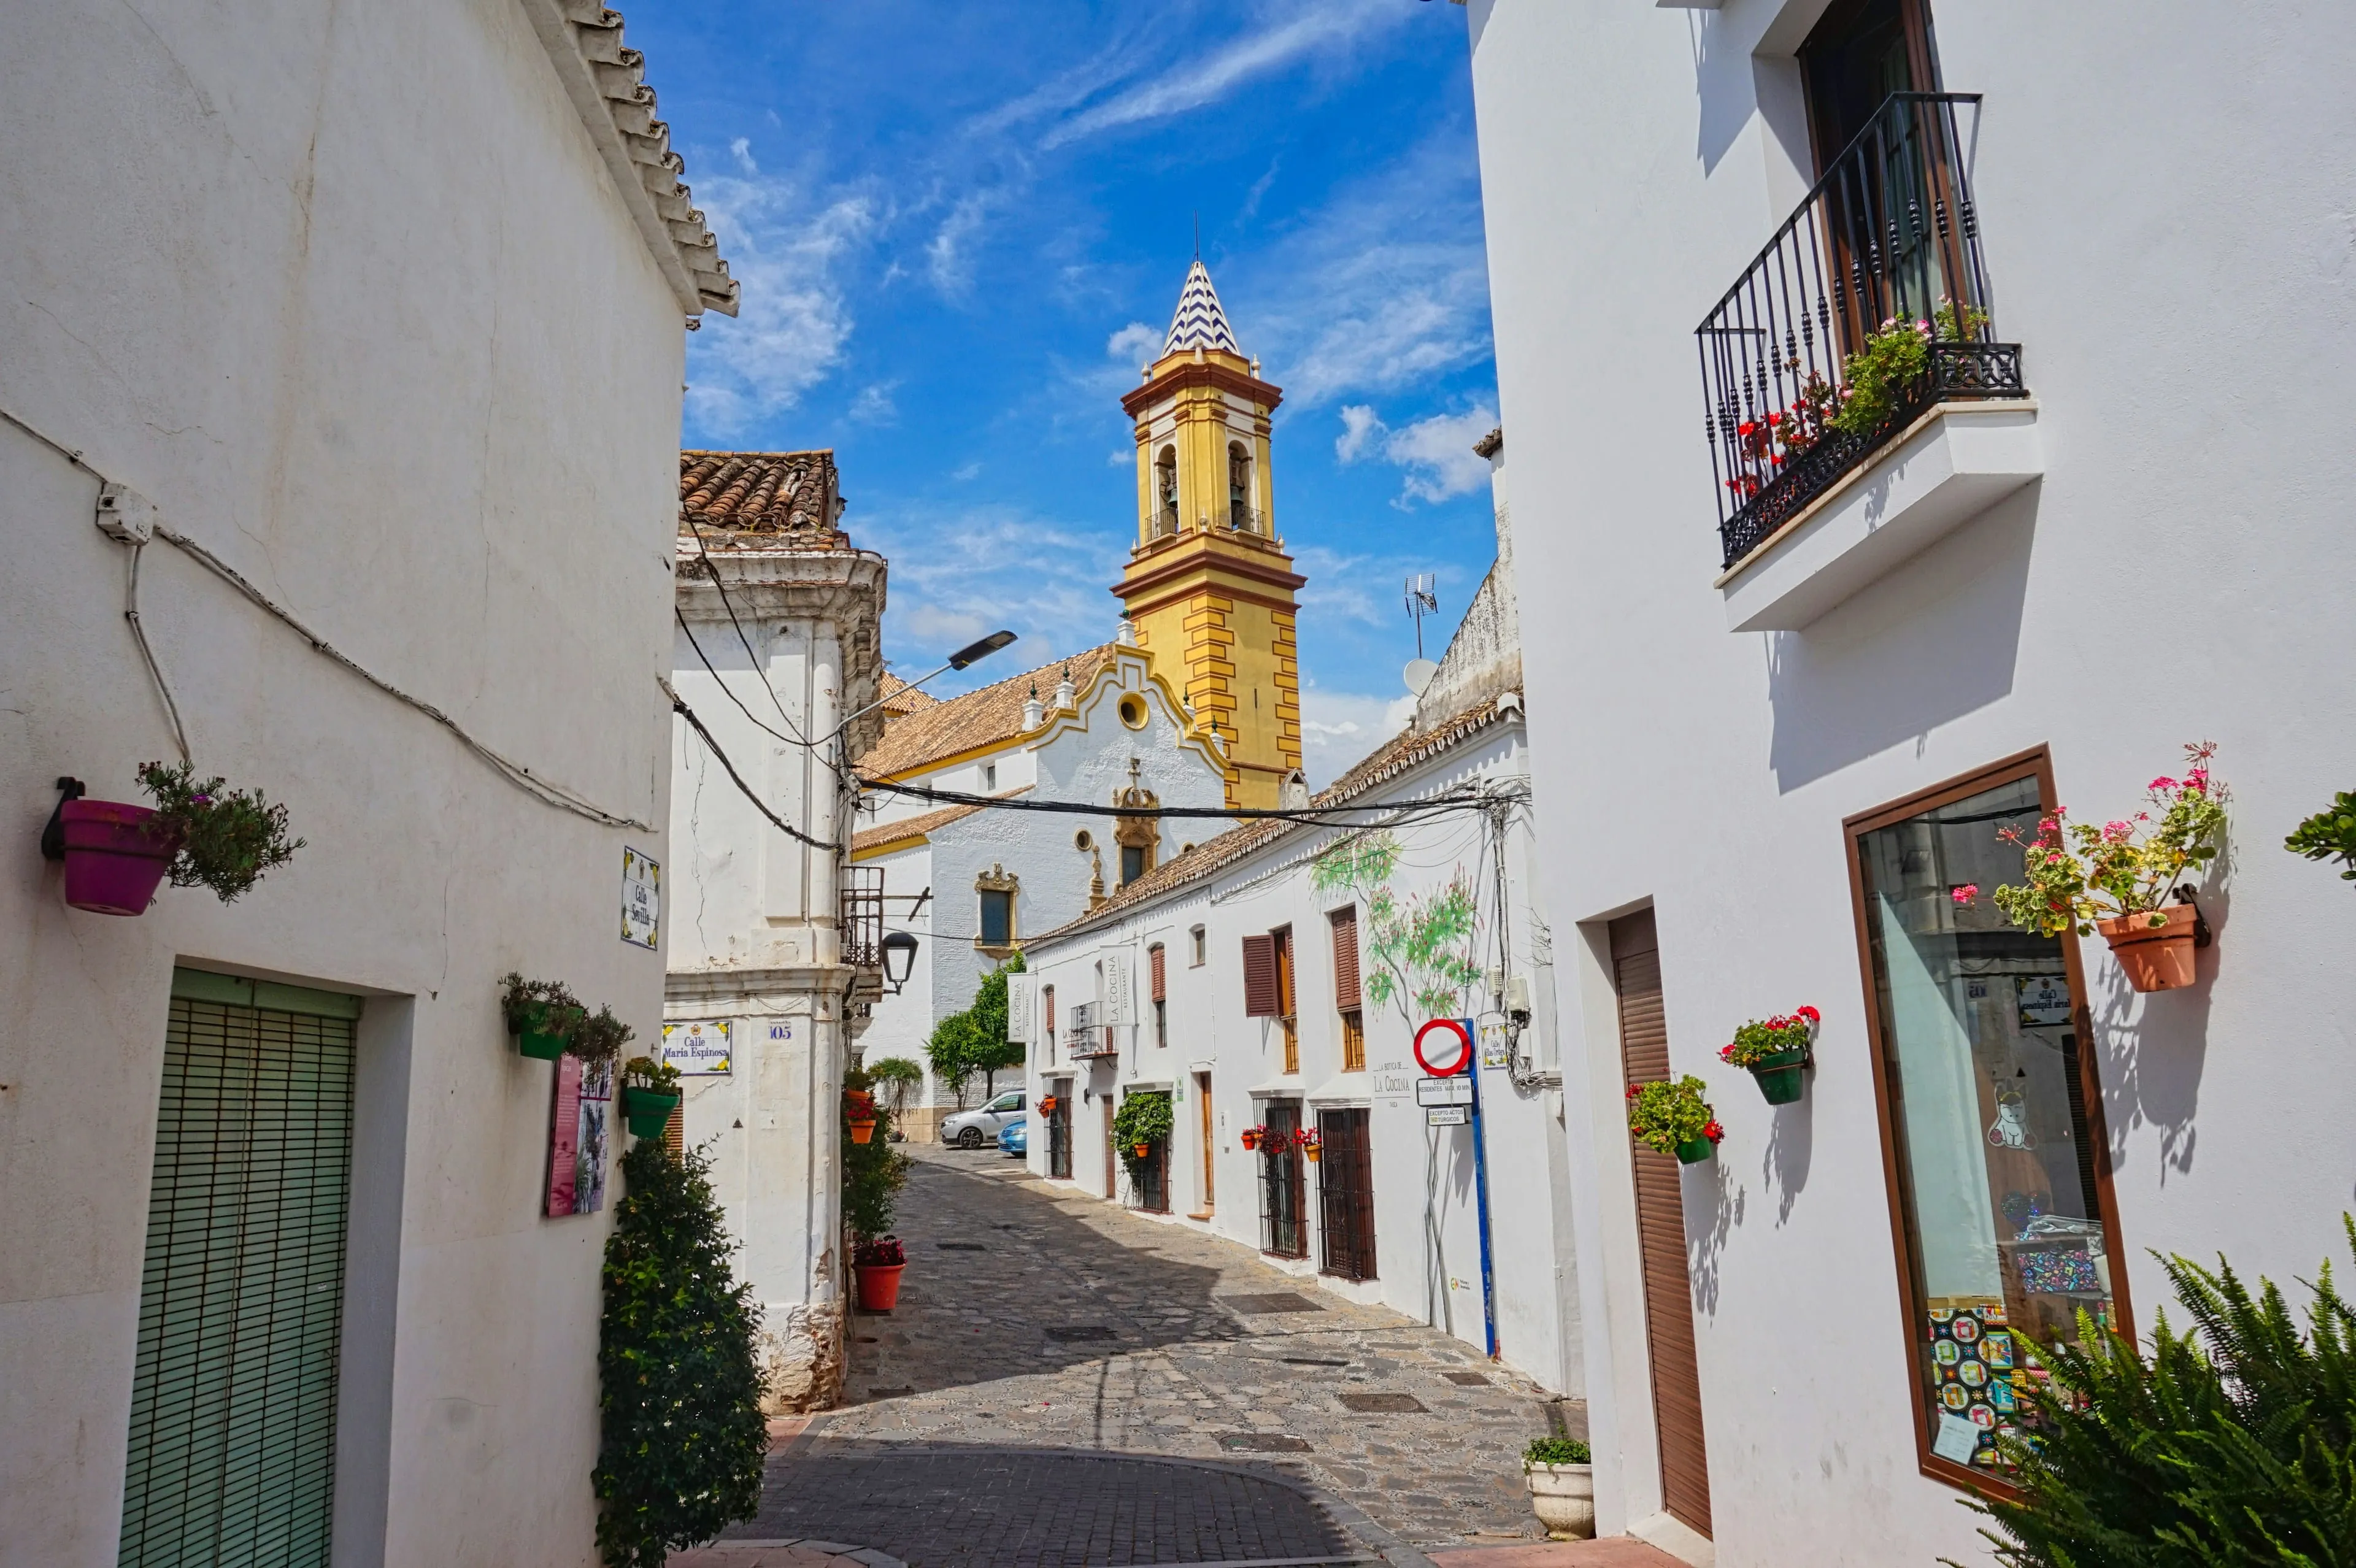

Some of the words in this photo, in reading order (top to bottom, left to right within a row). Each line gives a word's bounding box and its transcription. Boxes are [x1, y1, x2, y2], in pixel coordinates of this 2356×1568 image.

[636, 885, 647, 905] Calle
[632, 903, 650, 925] Sevilla
[1109, 956, 1118, 1004] COCINA
[1111, 1008, 1118, 1021] LA
[769, 1026, 791, 1040] 105
[1014, 1025, 1021, 1037] LA
[684, 1036, 706, 1047] Calle
[664, 1047, 688, 1058] Maria
[691, 1047, 728, 1060] Espinosa
[1384, 1062, 1397, 1070] BOTICA
[1397, 1061, 1402, 1070] DE
